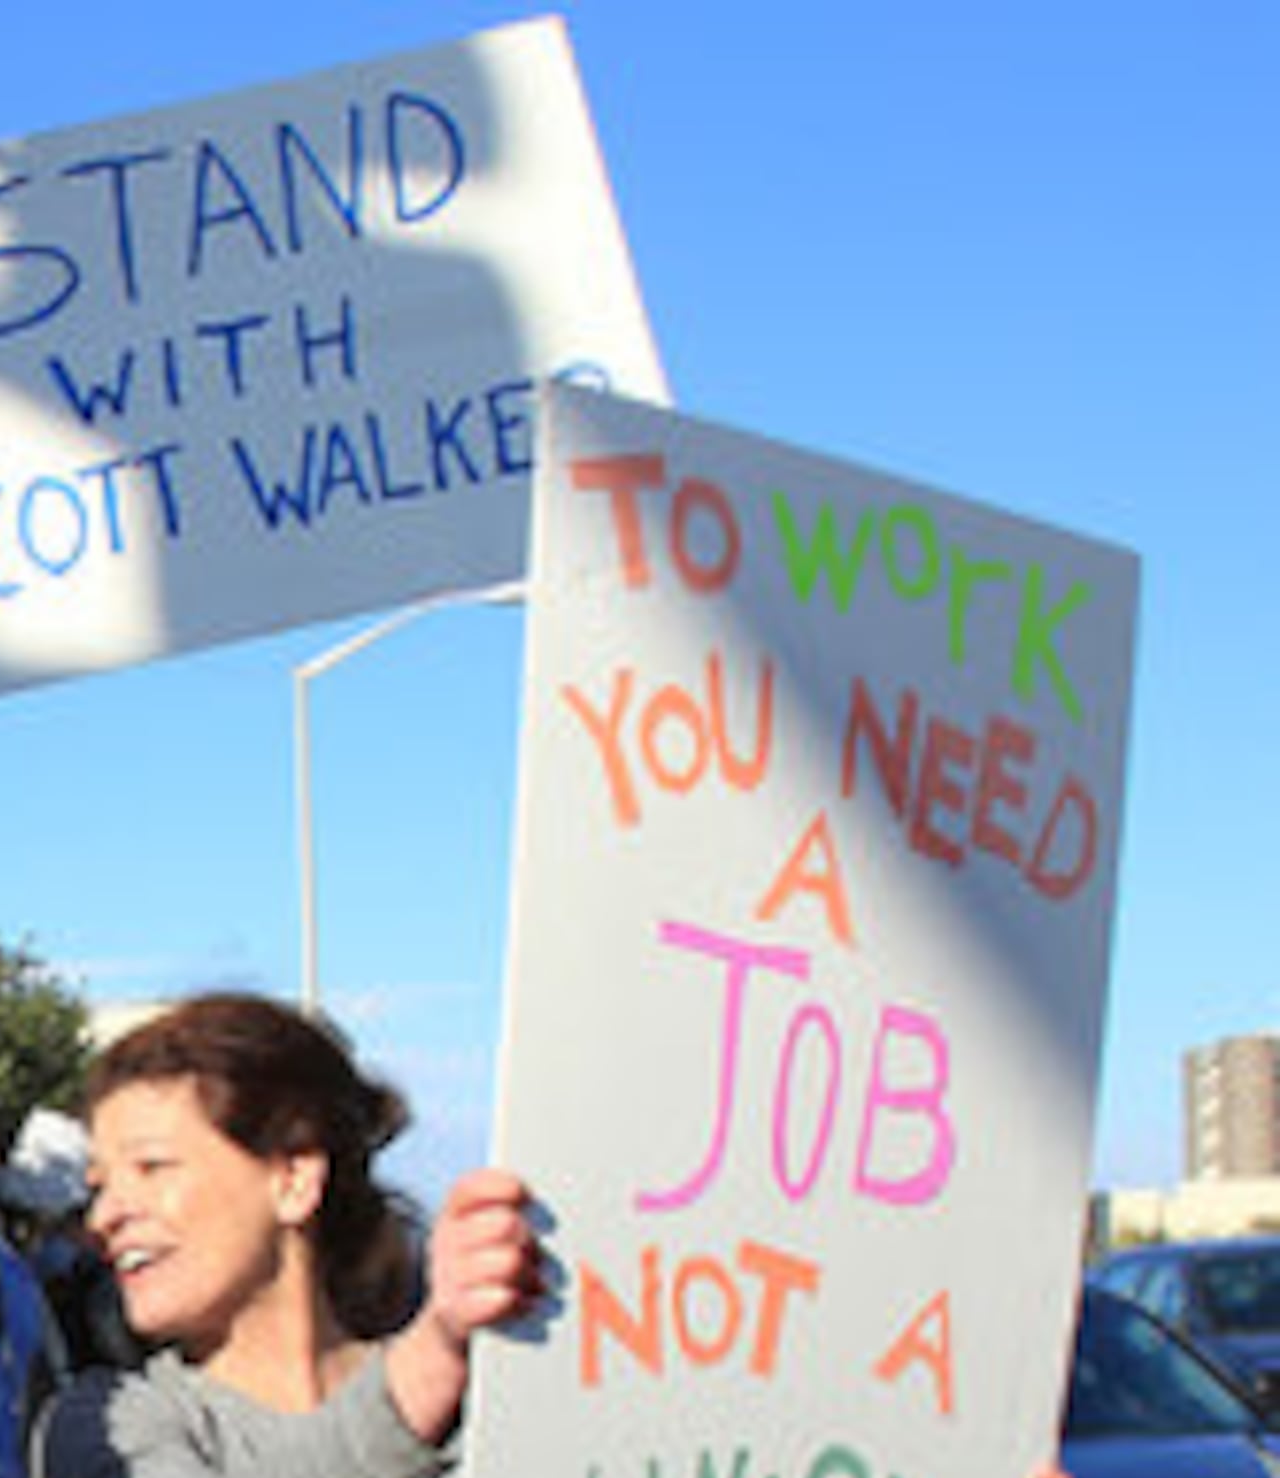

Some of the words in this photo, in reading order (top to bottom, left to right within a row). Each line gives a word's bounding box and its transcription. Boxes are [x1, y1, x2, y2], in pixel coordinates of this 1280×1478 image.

[47, 297, 358, 427] WITH
[232, 362, 614, 531] WALKE
[568, 453, 741, 595] TO
[561, 648, 777, 829] YOU
[840, 675, 1100, 900] NEED
[753, 808, 855, 950] A
[634, 920, 958, 1212] JOB
[579, 1237, 822, 1390] NOT
[873, 1288, 955, 1416] A
